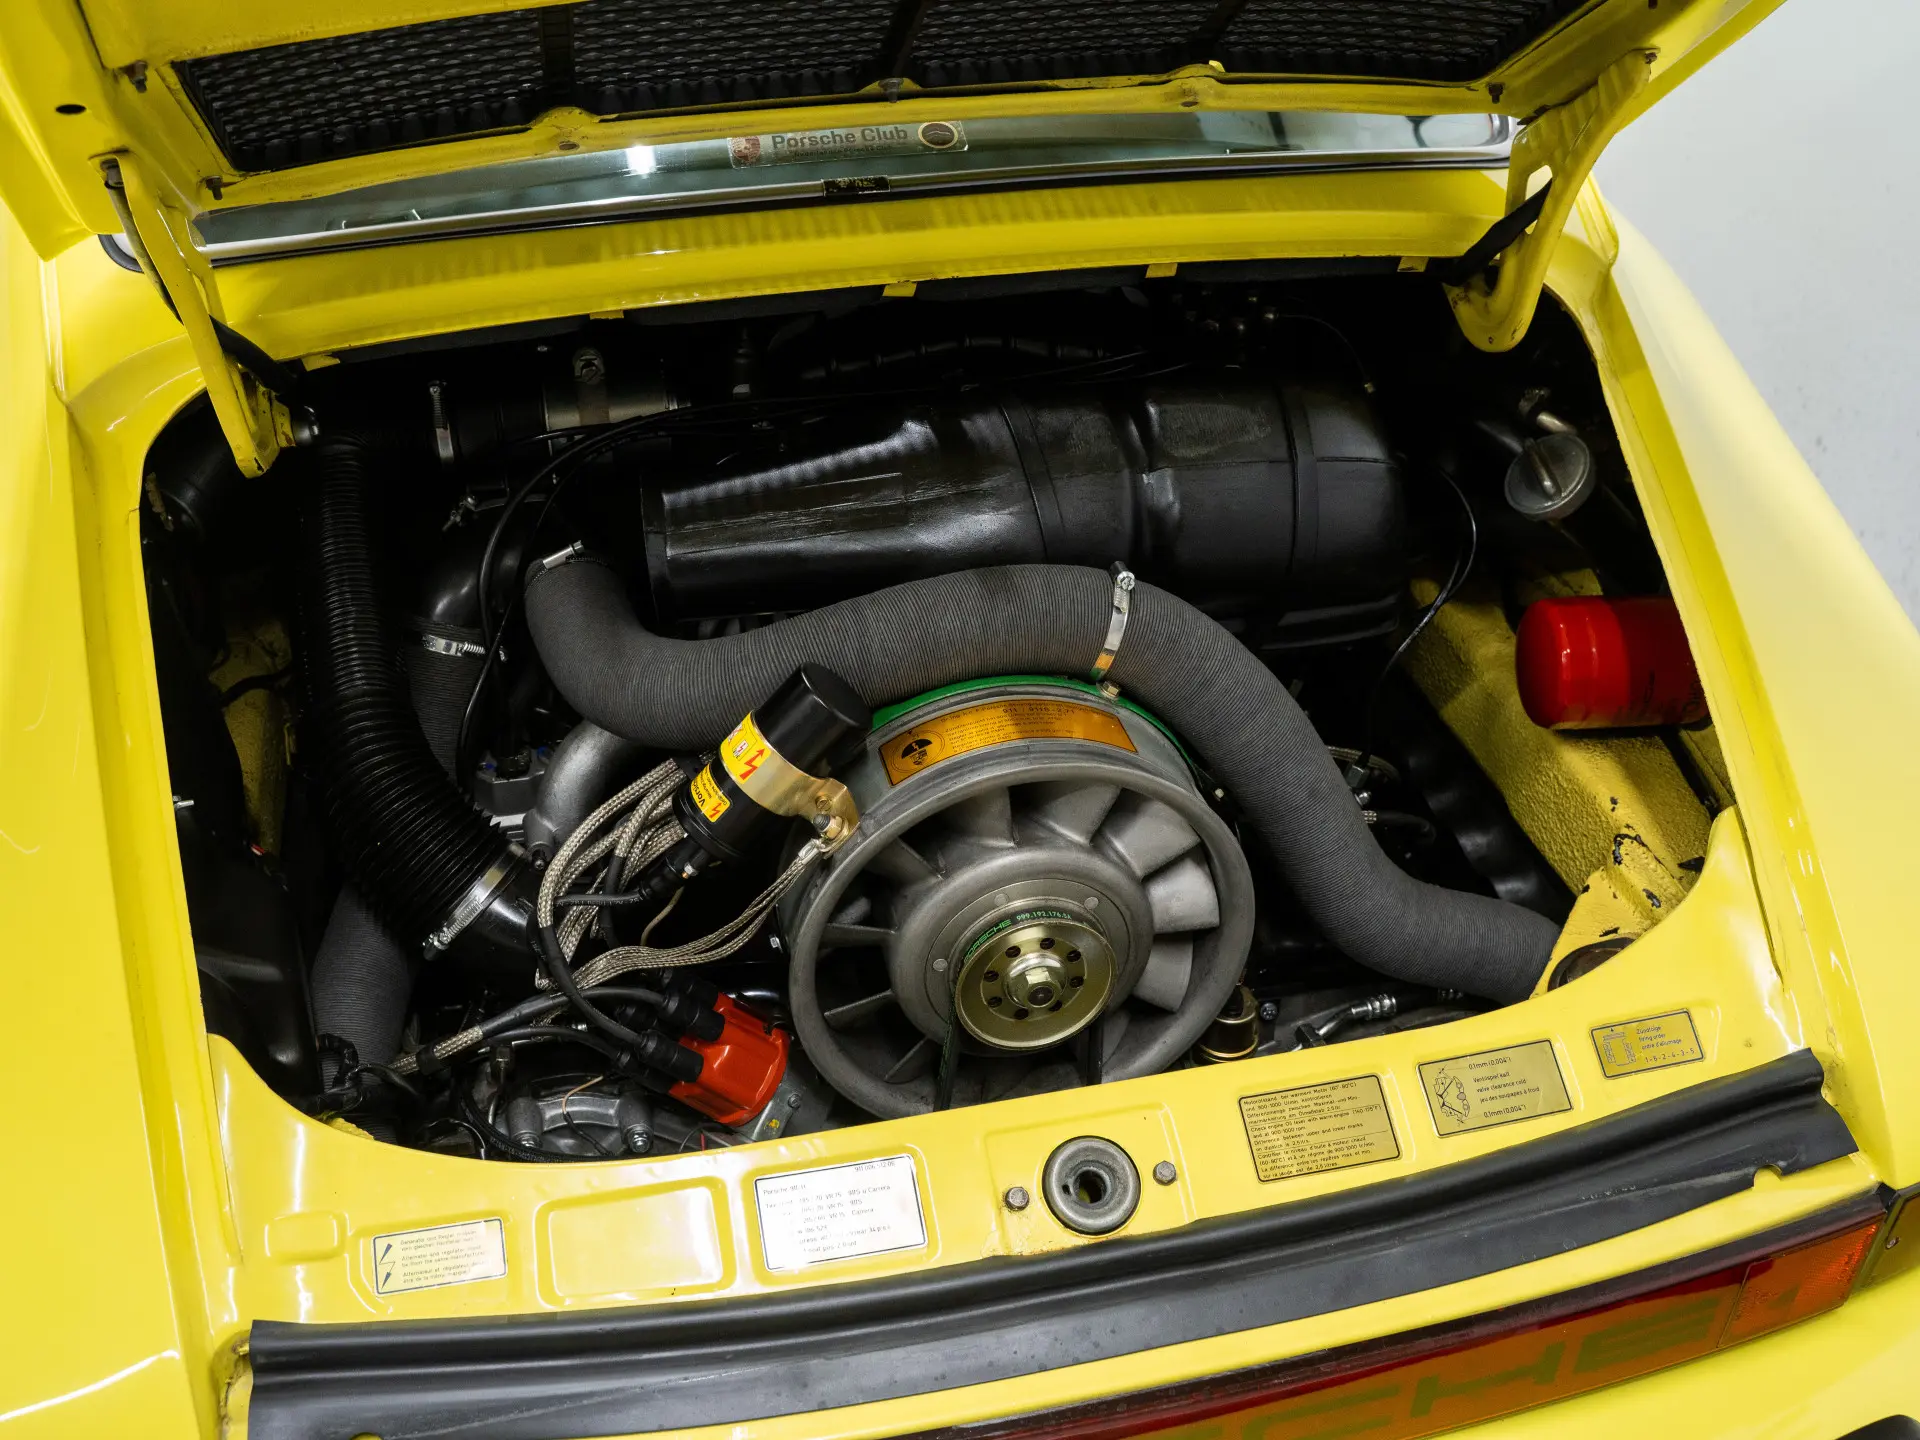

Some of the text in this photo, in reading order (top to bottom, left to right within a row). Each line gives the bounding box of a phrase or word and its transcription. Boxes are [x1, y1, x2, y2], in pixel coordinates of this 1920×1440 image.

[771, 127, 908, 150] Porsche Club
[1491, 1082, 1514, 1090] clearance
